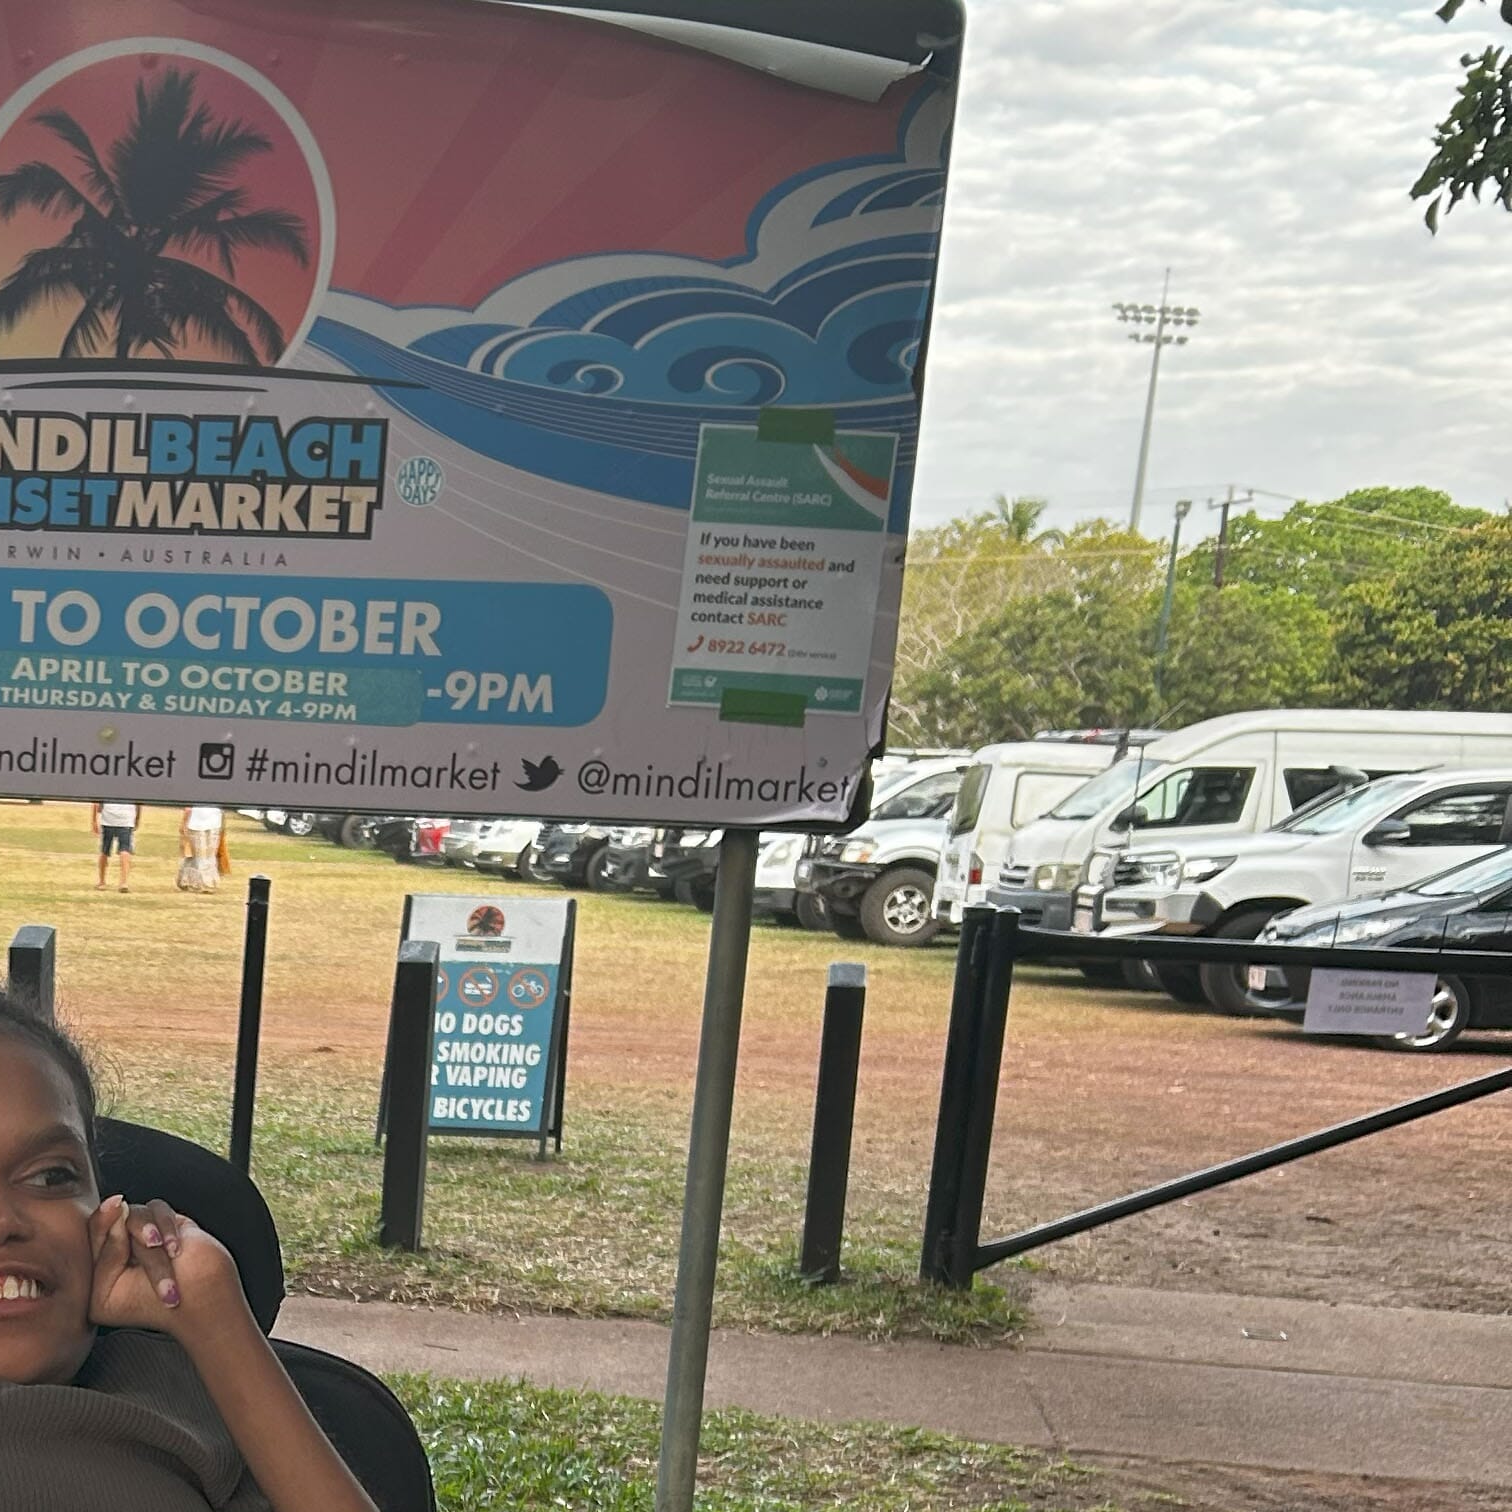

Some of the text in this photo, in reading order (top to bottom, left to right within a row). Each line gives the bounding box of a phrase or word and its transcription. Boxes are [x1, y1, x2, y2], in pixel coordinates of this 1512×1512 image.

[399, 459, 441, 484] HAPPY
[402, 483, 437, 503] DAYS
[700, 532, 815, 551] If you have been
[121, 548, 289, 567] AUSTRALIA
[697, 553, 855, 573] sexually assaulted and
[695, 573, 808, 590] need support or
[693, 590, 823, 610] medical assistance
[12, 588, 101, 646] TO
[125, 592, 443, 656] OCTOBER
[691, 611, 787, 627] contact SARC
[707, 638, 745, 654] 8922
[748, 640, 786, 656] 6472
[11, 656, 349, 697] APRIL TO OCTOBER
[0, 686, 357, 721] THURSDAY & SUNDAY 4-9PM
[246, 747, 501, 792] #mindilmarket
[578, 760, 850, 803] @mindilmarket
[462, 1013, 524, 1036] DOGS
[437, 1041, 541, 1066] SMOKING
[446, 1065, 527, 1089] VAPING
[433, 1096, 532, 1122] BICYCLES
